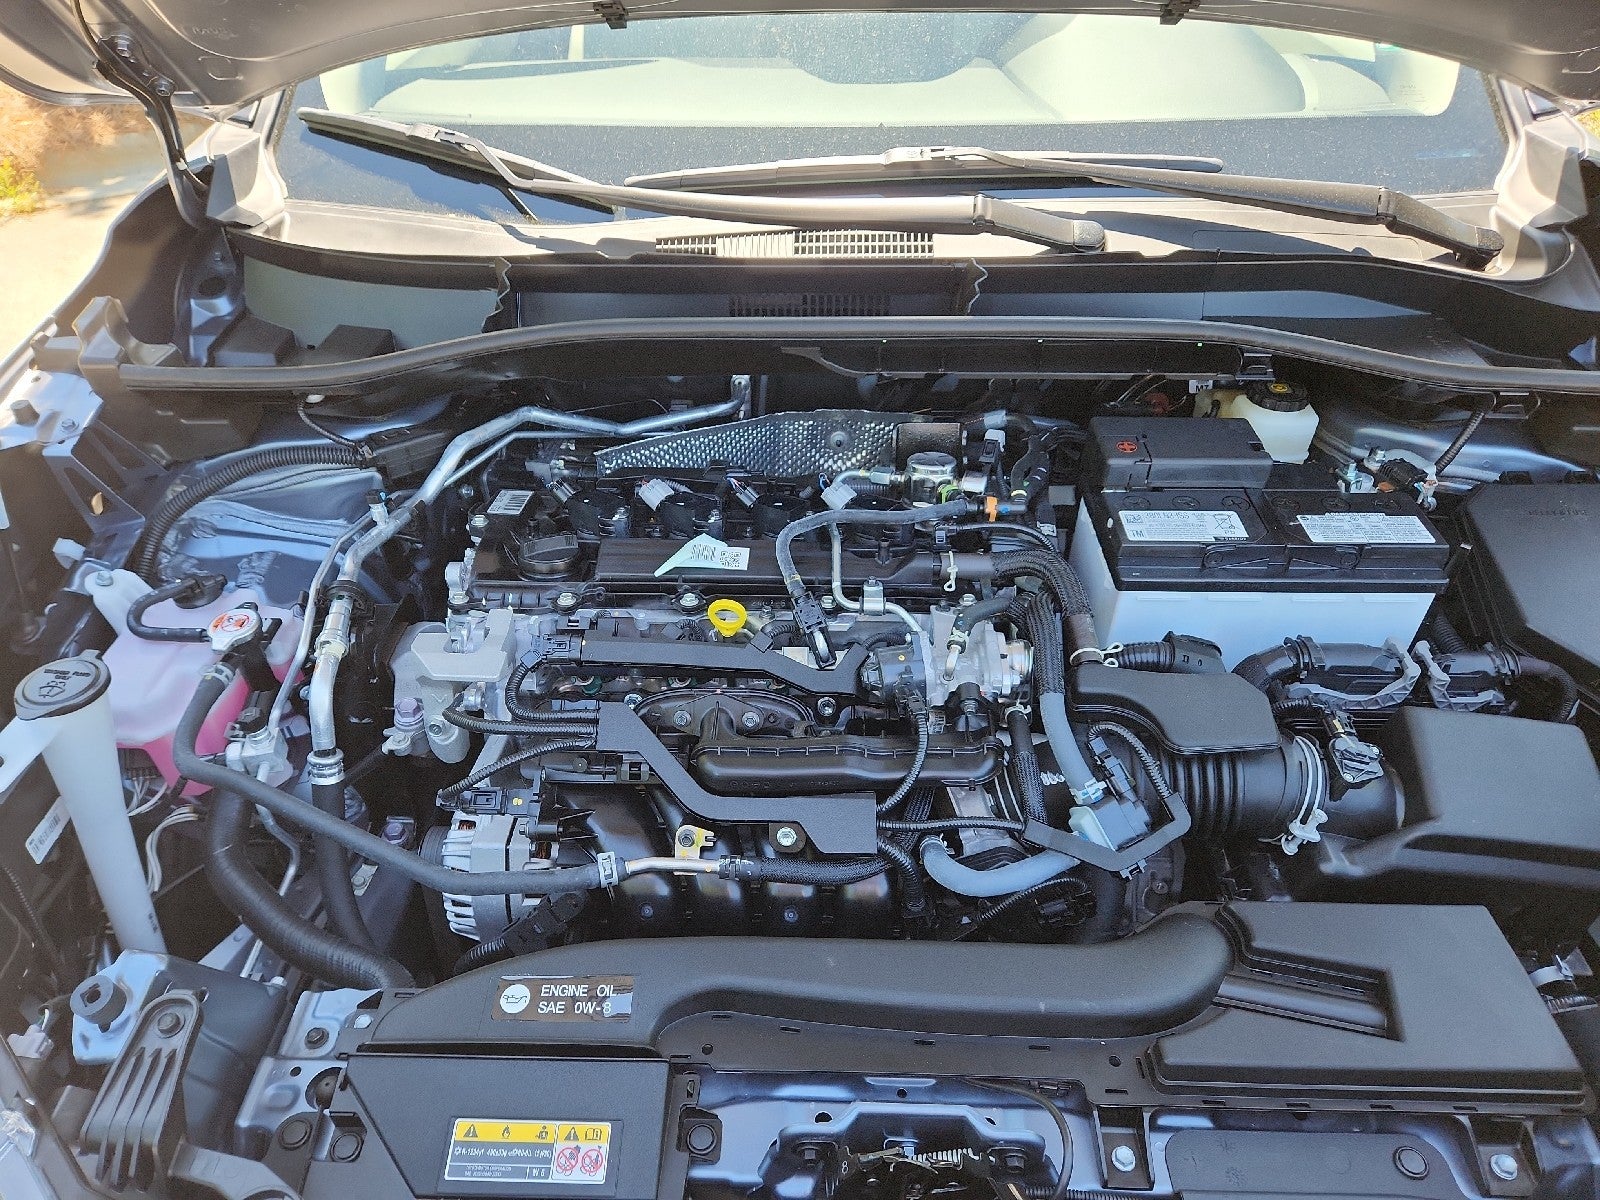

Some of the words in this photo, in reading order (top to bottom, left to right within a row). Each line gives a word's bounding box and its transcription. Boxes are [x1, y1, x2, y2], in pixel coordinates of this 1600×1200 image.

[540, 984, 589, 997] ENGINE
[597, 984, 618, 997] OIL
[537, 1001, 566, 1014] SAE
[574, 1001, 612, 1014] 0W-8
[841, 1160, 849, 1175] 8
